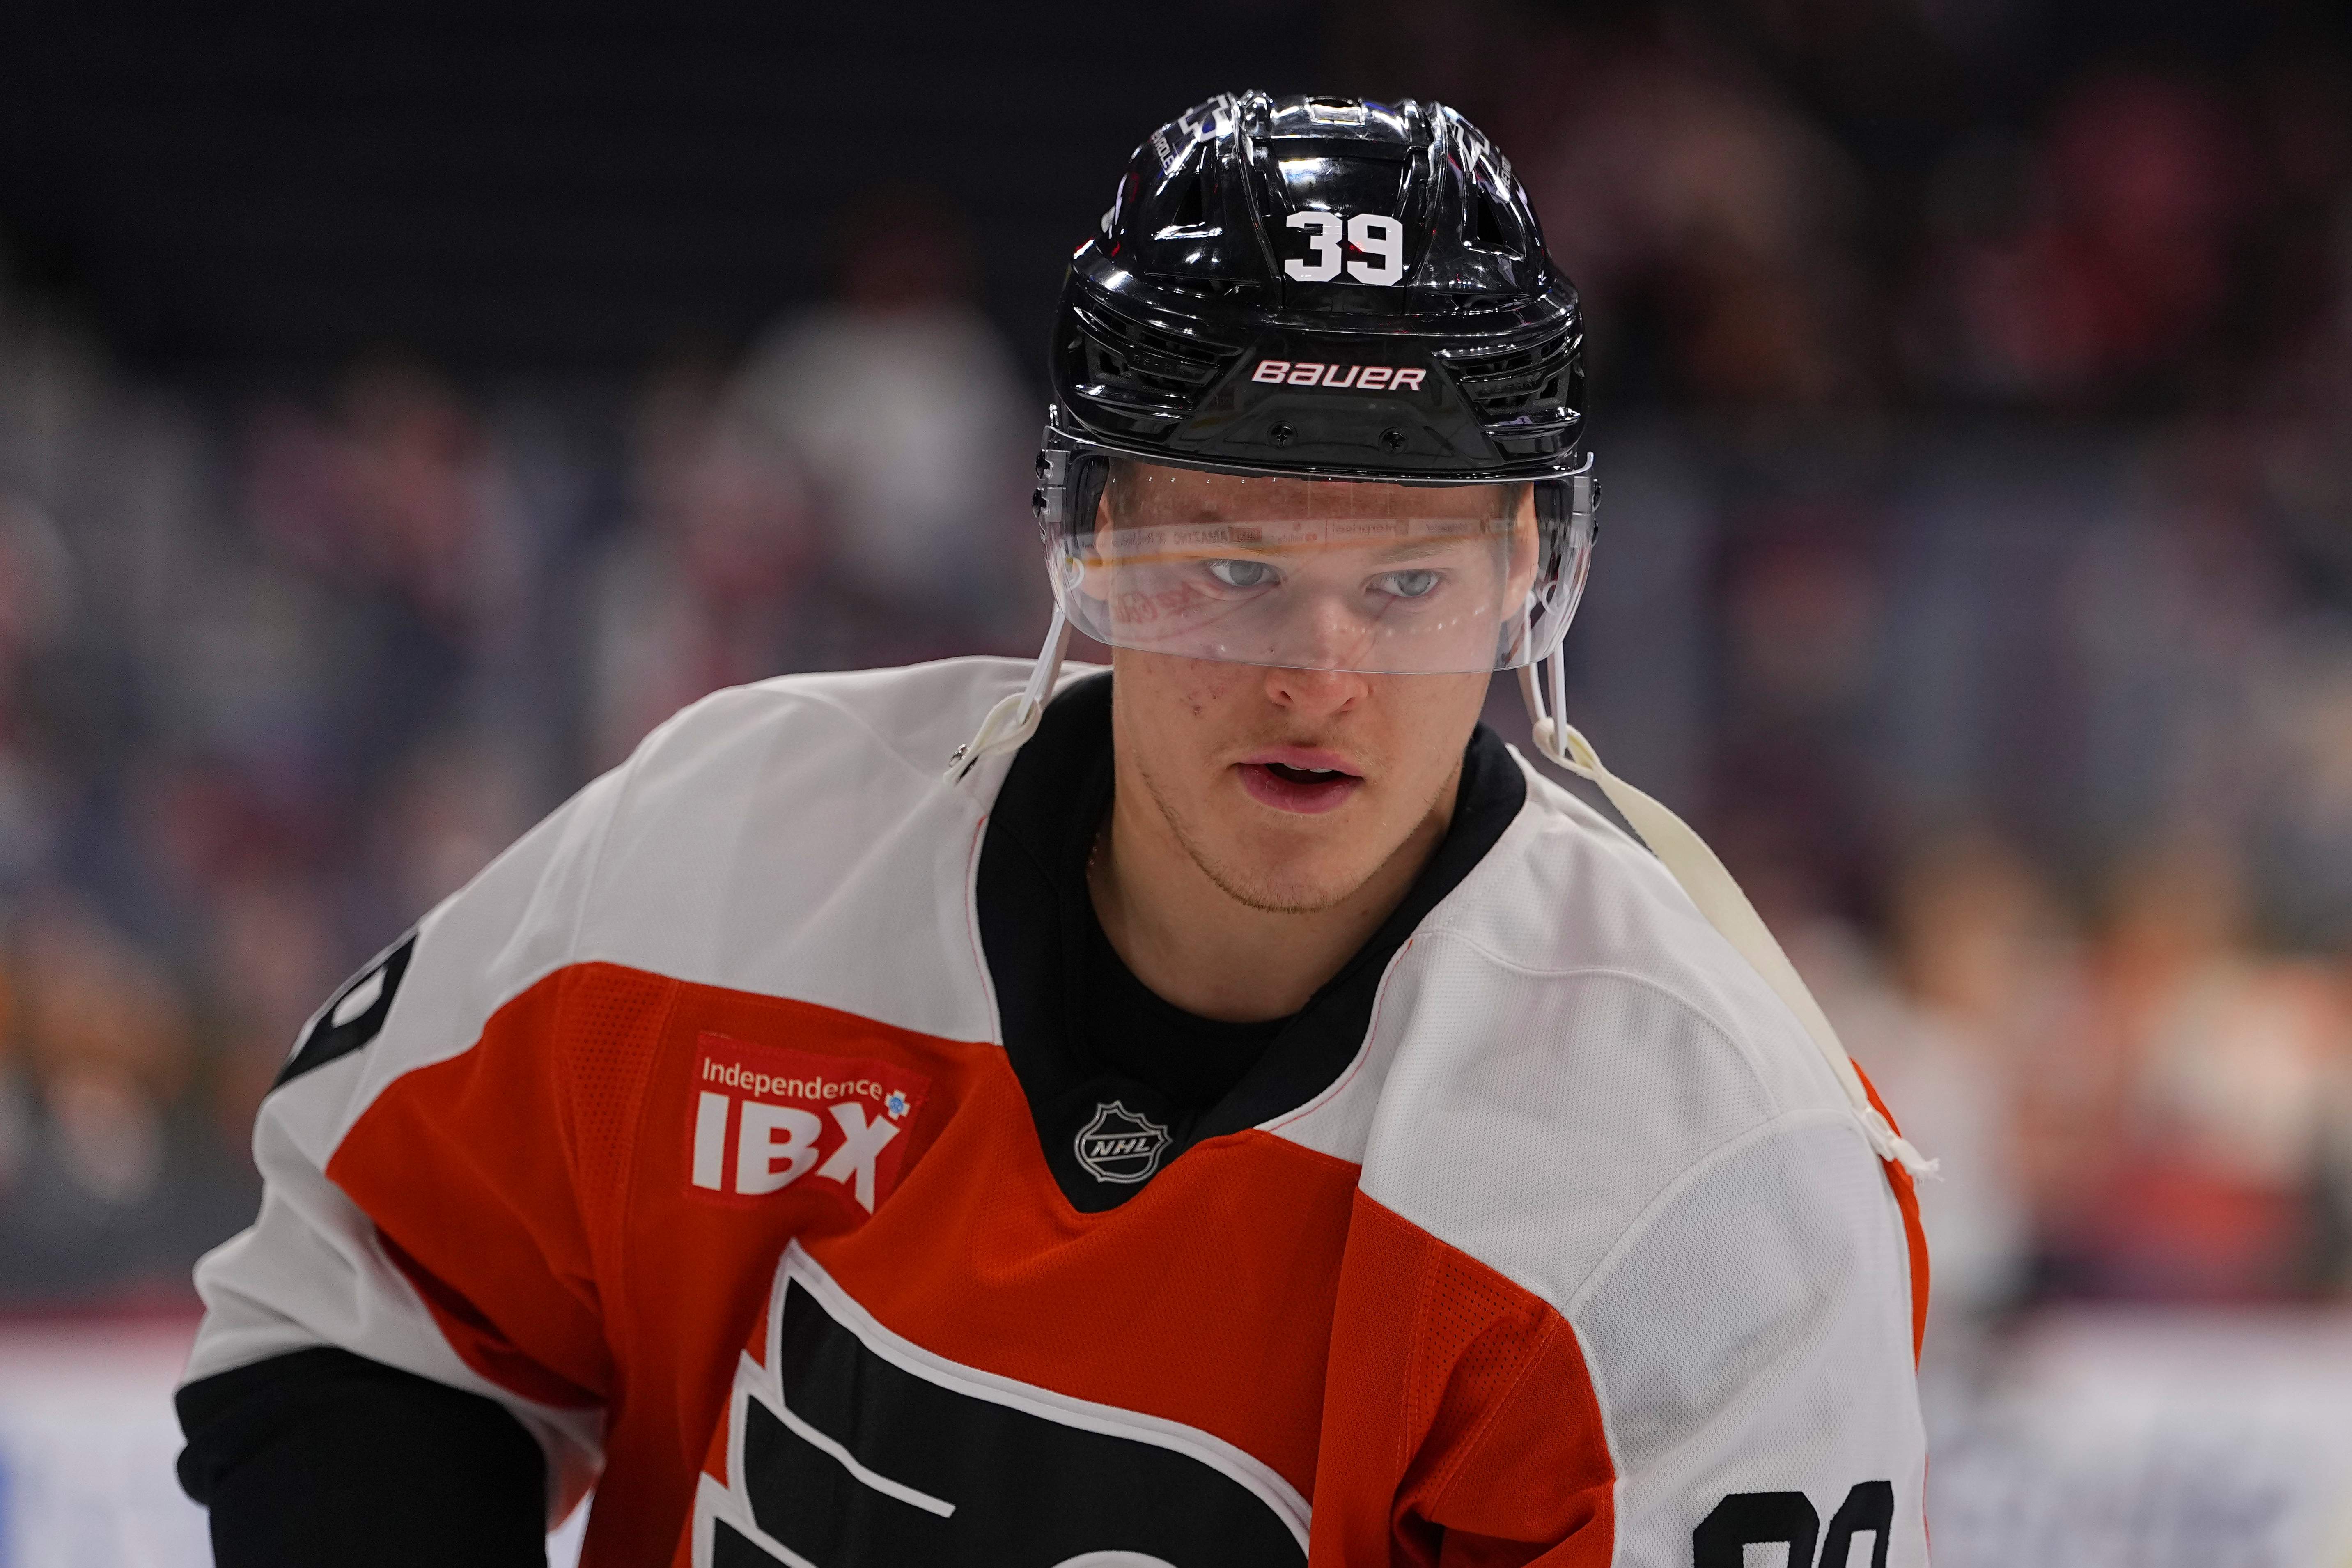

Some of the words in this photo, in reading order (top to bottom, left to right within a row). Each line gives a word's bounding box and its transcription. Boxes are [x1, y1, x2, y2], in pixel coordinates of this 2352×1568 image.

[1284, 211, 1403, 287] 39
[1251, 360, 1427, 391] BAUER
[702, 1057, 882, 1101] Independence
[693, 1091, 900, 1214] IBX
[1090, 1137, 1150, 1157] NHL
